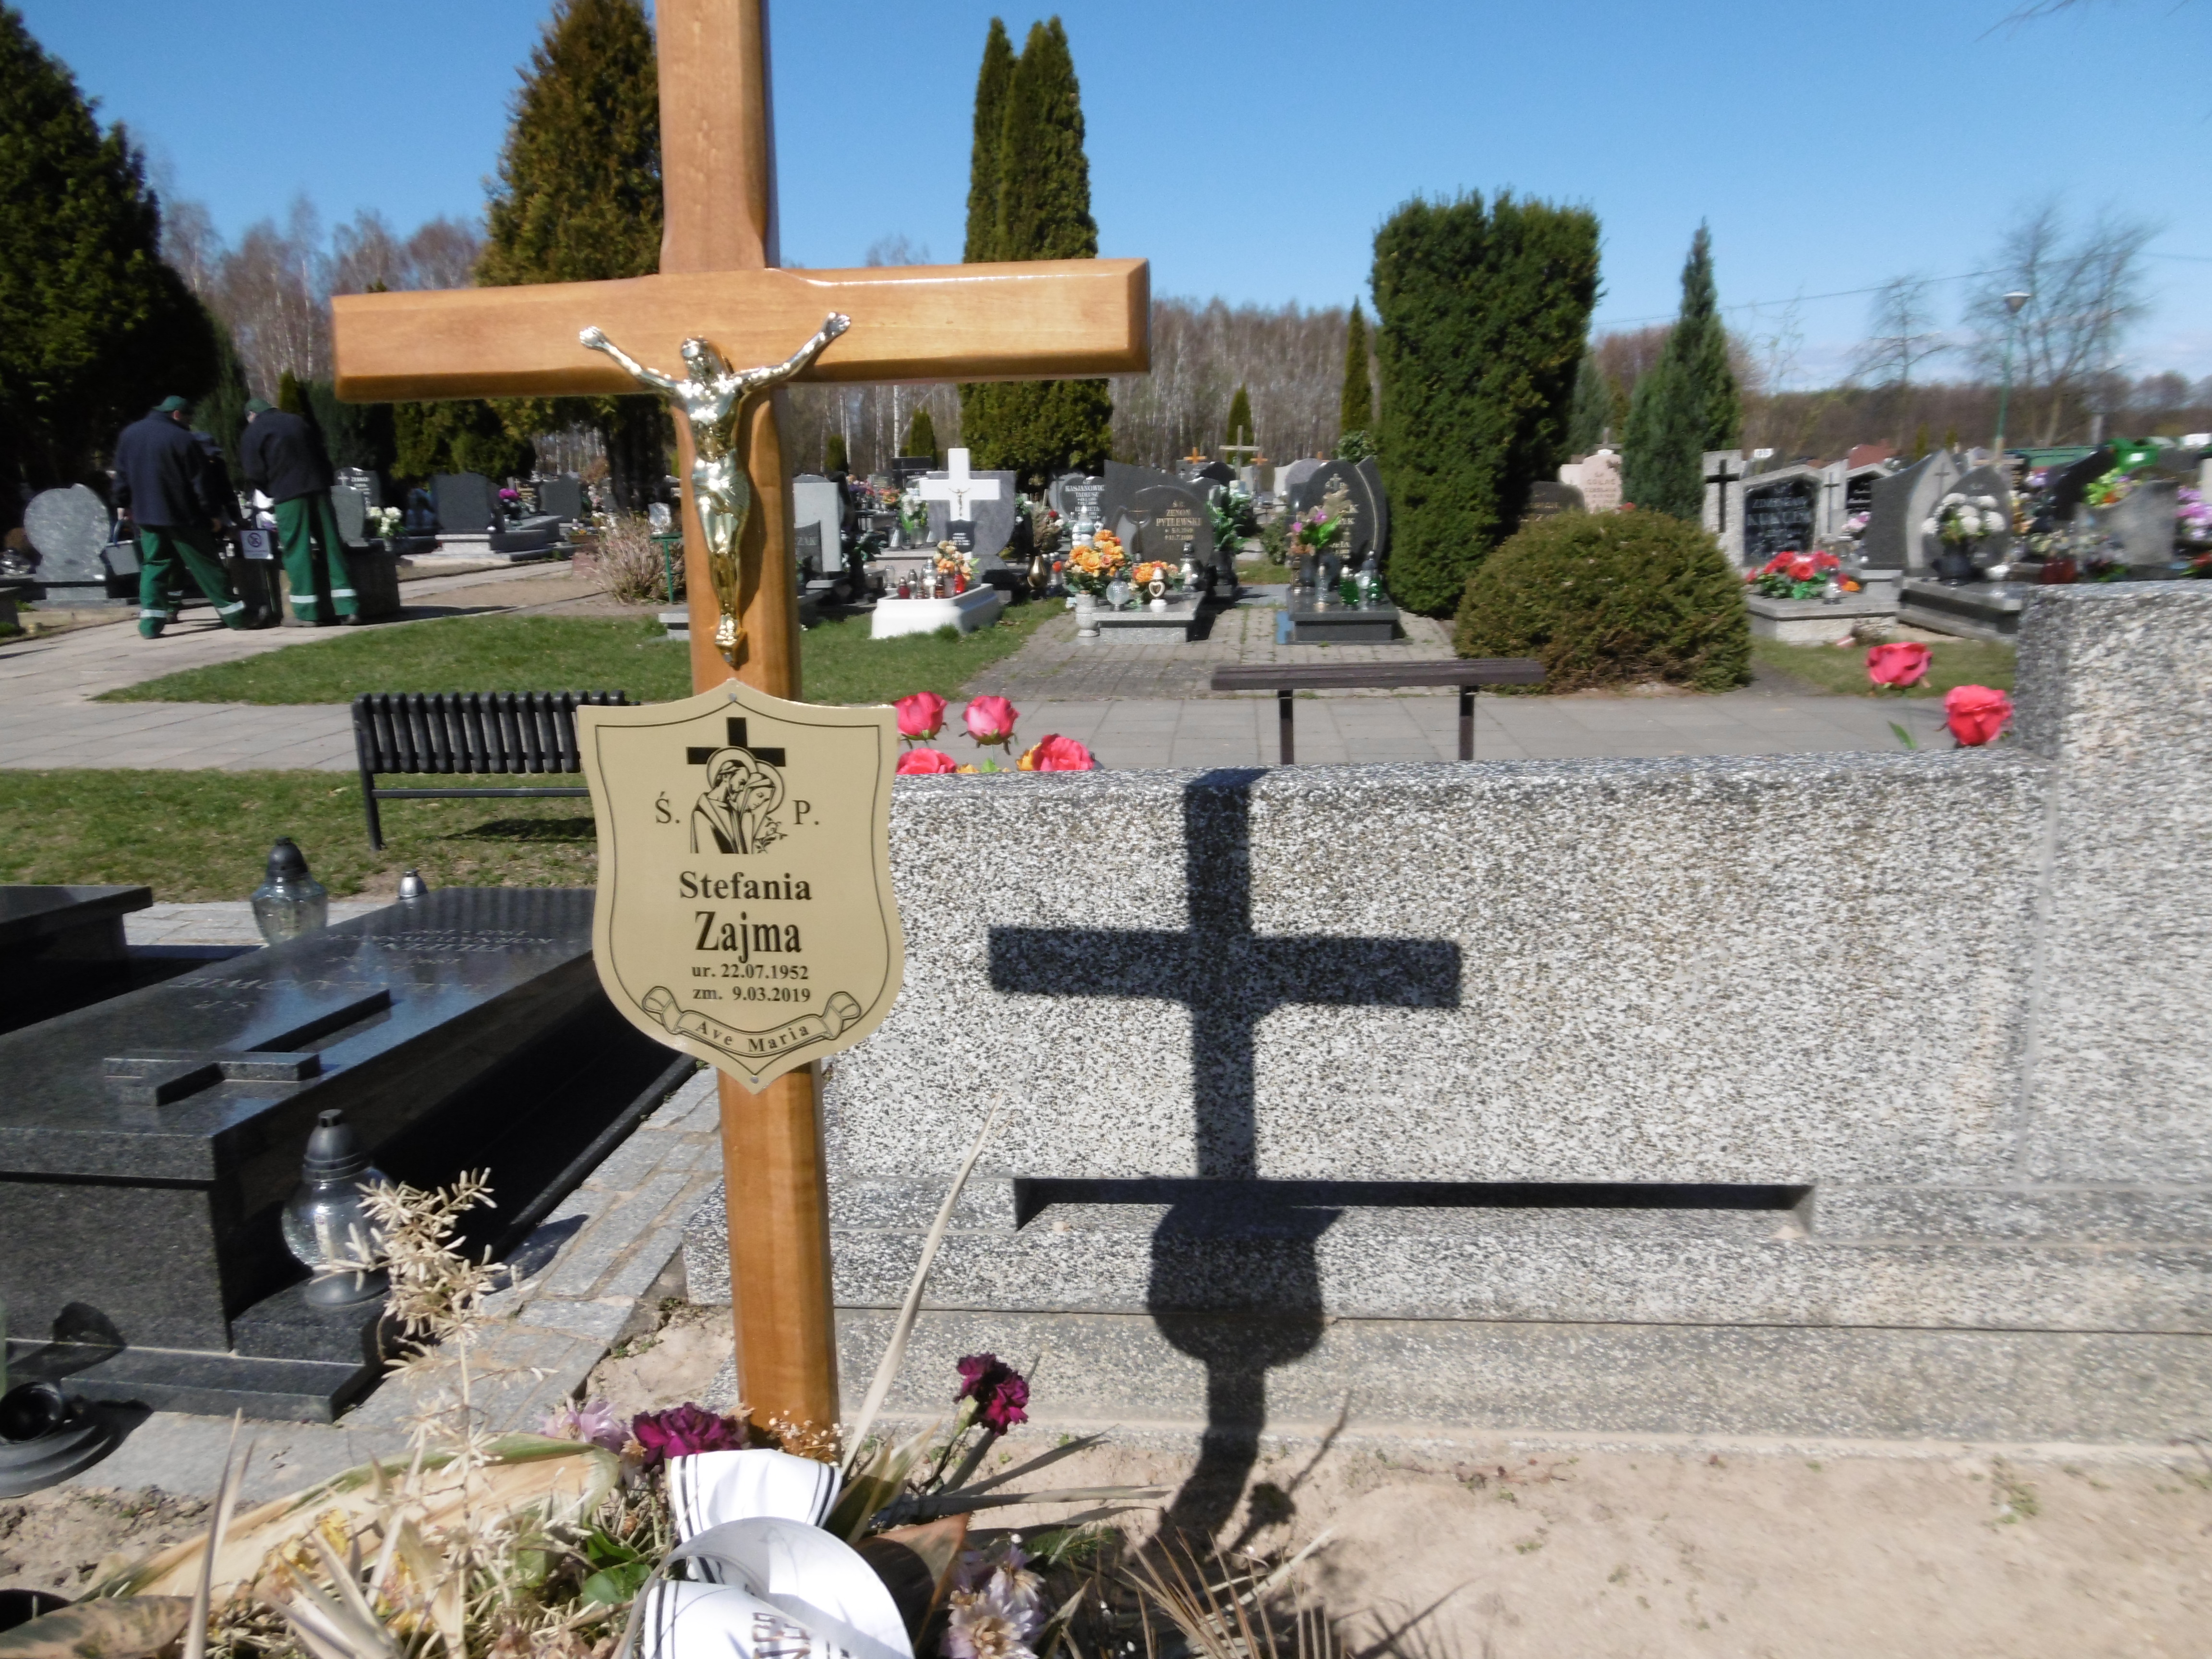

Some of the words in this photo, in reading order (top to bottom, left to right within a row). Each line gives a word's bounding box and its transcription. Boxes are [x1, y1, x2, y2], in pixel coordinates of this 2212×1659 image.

[1156, 517, 1202, 527] PYTLEWSKI
[655, 790, 680, 825] Ś.
[792, 799, 819, 826] P.
[679, 870, 812, 901] Stefania
[695, 910, 802, 964] Zajma
[691, 966, 716, 978] ur.
[721, 963, 809, 980] 22.07.1952
[692, 988, 723, 1000] zm.
[732, 986, 810, 1003] 9.03.2019
[695, 1020, 734, 1046] Ave
[747, 1024, 811, 1053] Maria
